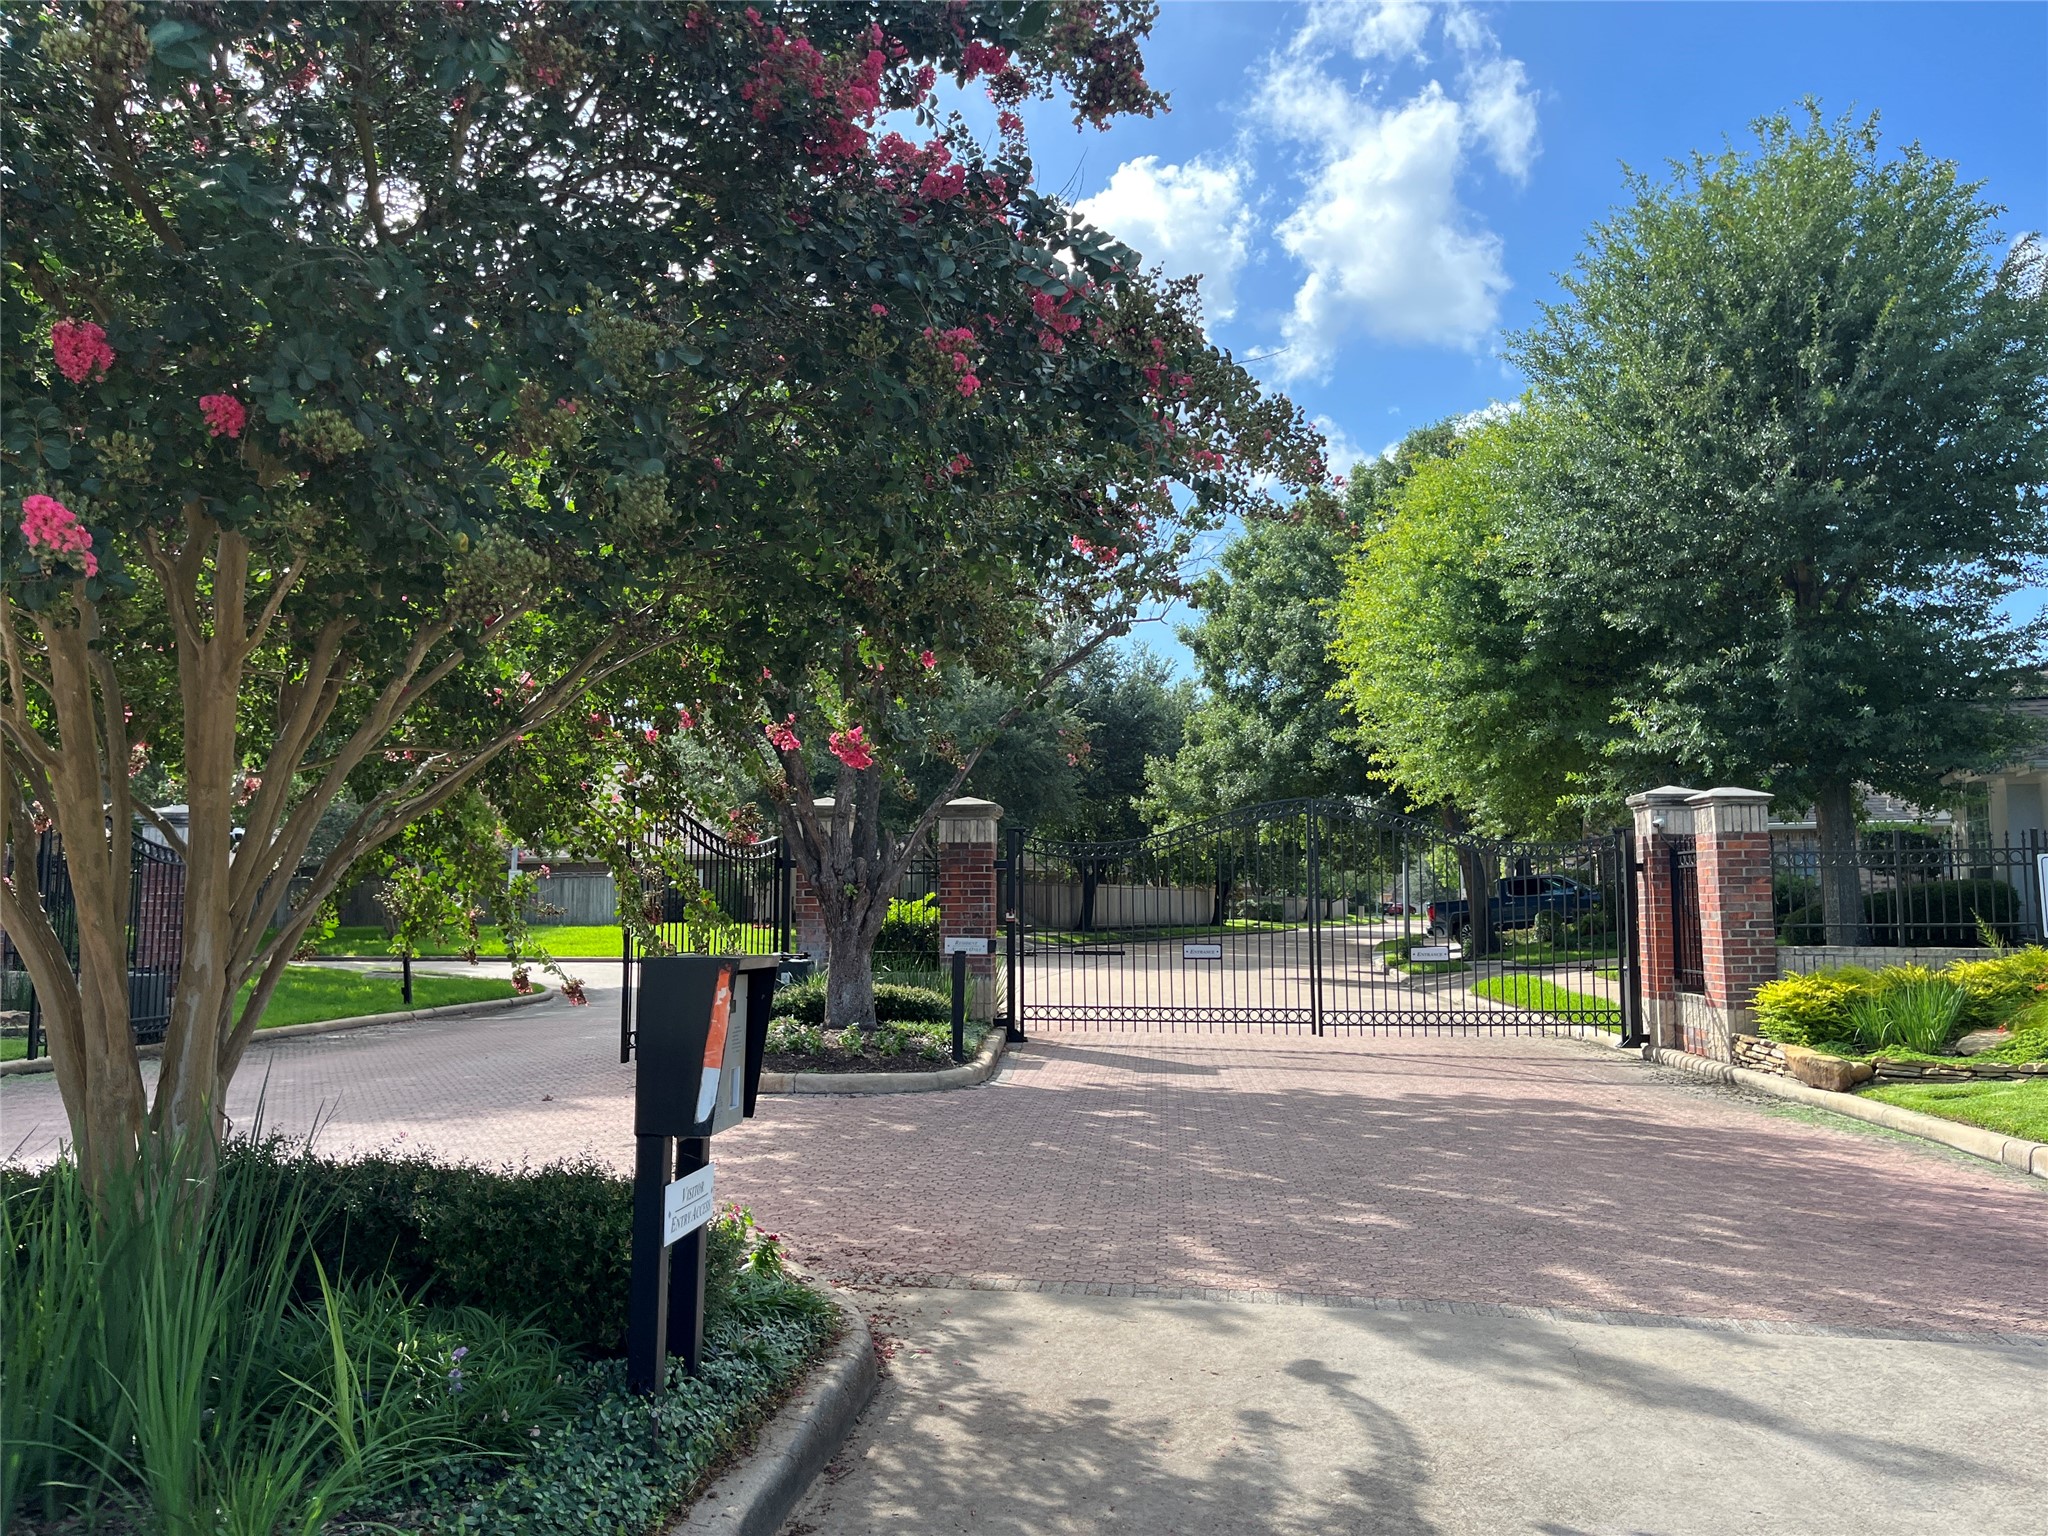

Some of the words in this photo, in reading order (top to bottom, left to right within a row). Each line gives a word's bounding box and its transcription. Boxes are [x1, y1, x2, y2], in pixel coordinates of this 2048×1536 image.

[682, 1181, 704, 1202] VISITOR
[671, 1211, 691, 1233] ENTRY
[691, 1199, 711, 1220] ACCESS
